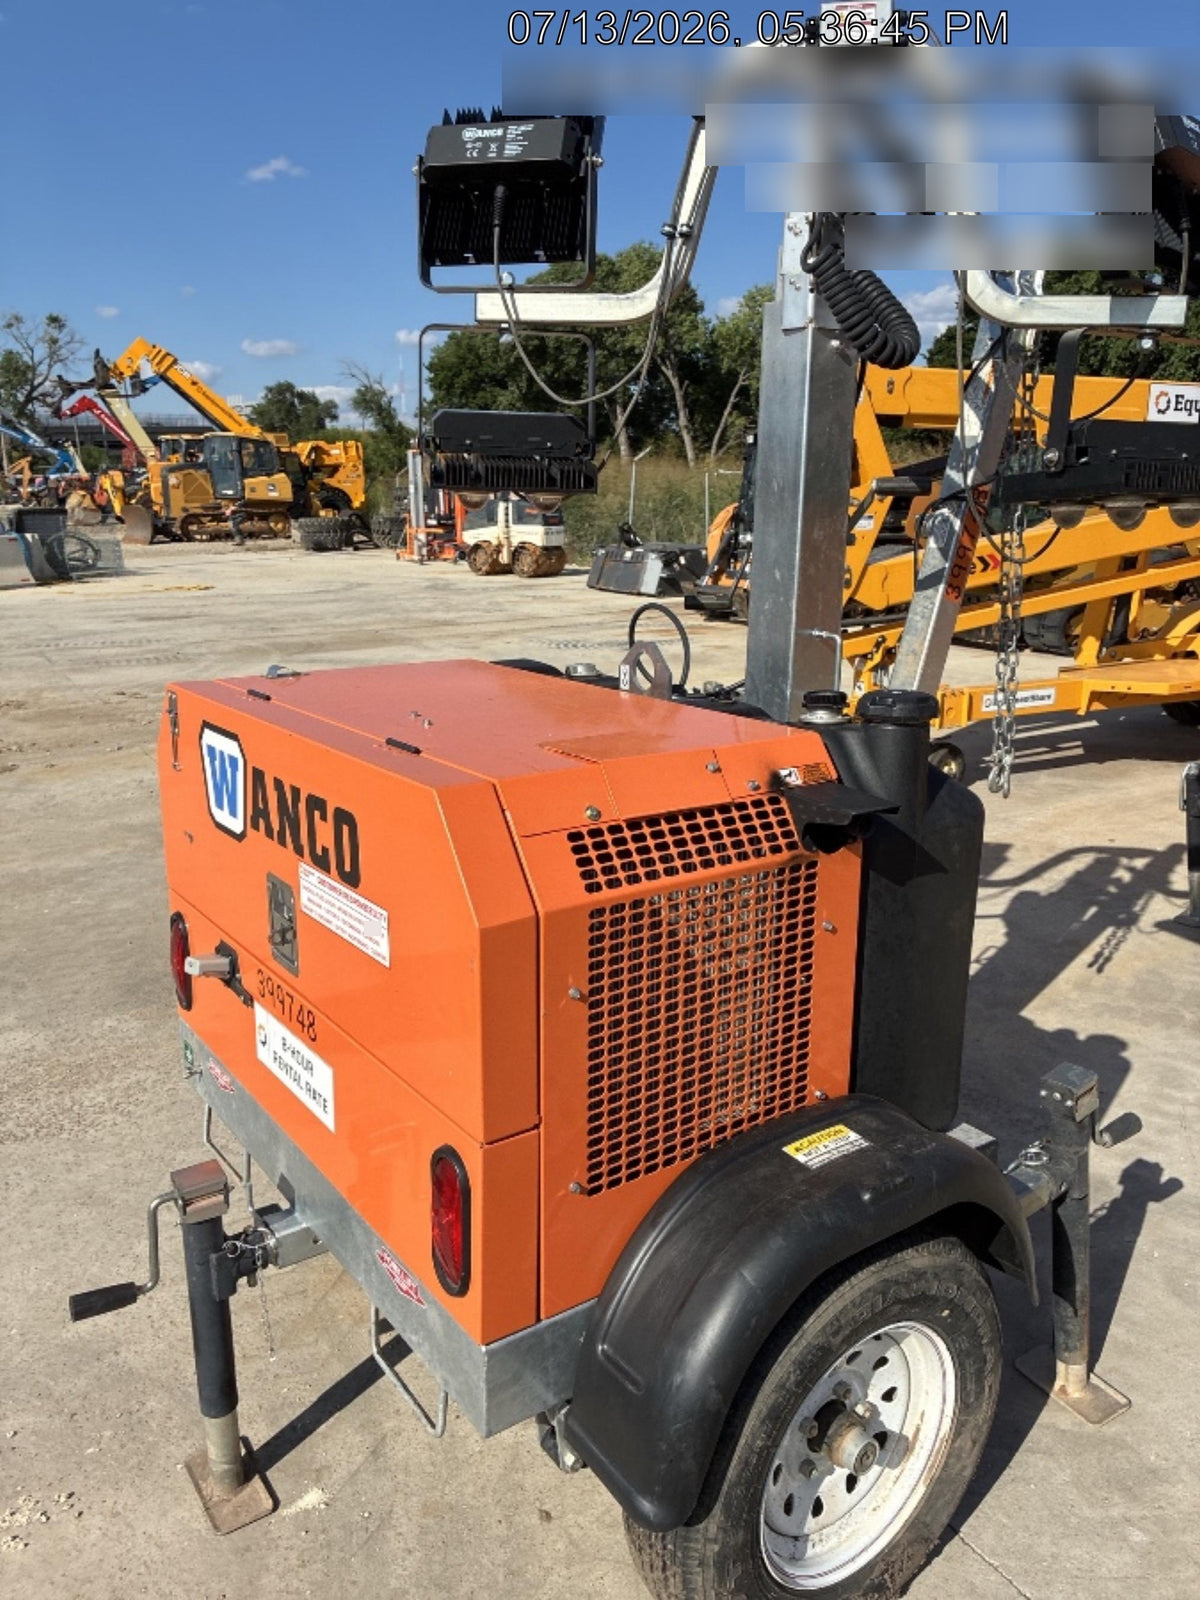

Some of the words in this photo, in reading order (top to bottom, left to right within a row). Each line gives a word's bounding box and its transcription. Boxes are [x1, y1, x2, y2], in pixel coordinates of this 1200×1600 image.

[203, 738, 361, 889] WANCO
[256, 968, 317, 1042] 399748
[272, 1050, 303, 1090] RENTAL
[305, 1079, 329, 1114] RATE
[800, 1128, 844, 1148] CAUTION
